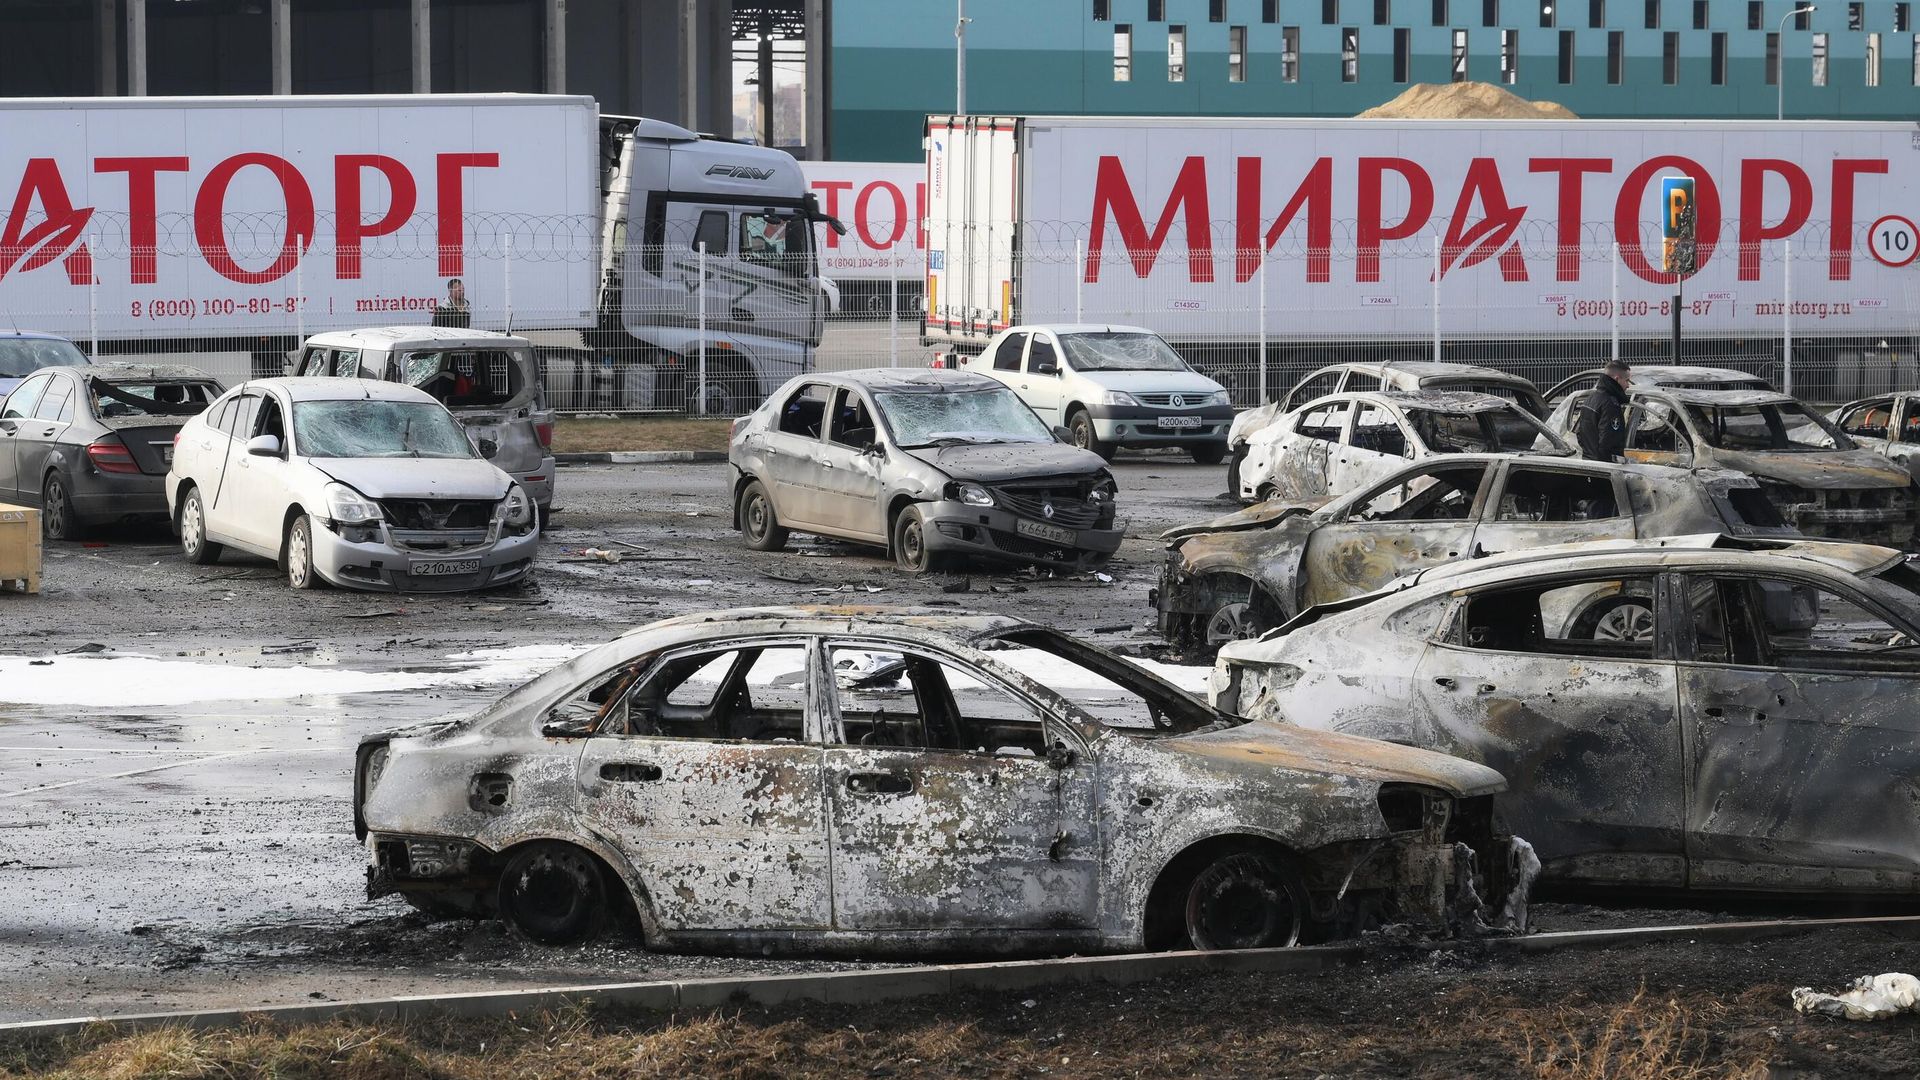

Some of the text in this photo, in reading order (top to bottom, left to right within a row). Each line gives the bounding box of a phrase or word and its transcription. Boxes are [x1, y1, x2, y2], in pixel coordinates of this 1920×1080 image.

[705, 164, 776, 180] FAW
[1670, 188, 1688, 228] P
[1084, 154, 1889, 285] МИРАТОРГ
[1882, 230, 1909, 251] 10
[930, 251, 943, 269] TIR
[131, 299, 142, 318] 8
[148, 298, 197, 320] (800)
[1557, 300, 1566, 316] 8
[1572, 299, 1614, 320] (800)
[1619, 300, 1713, 316] 100-8-87
